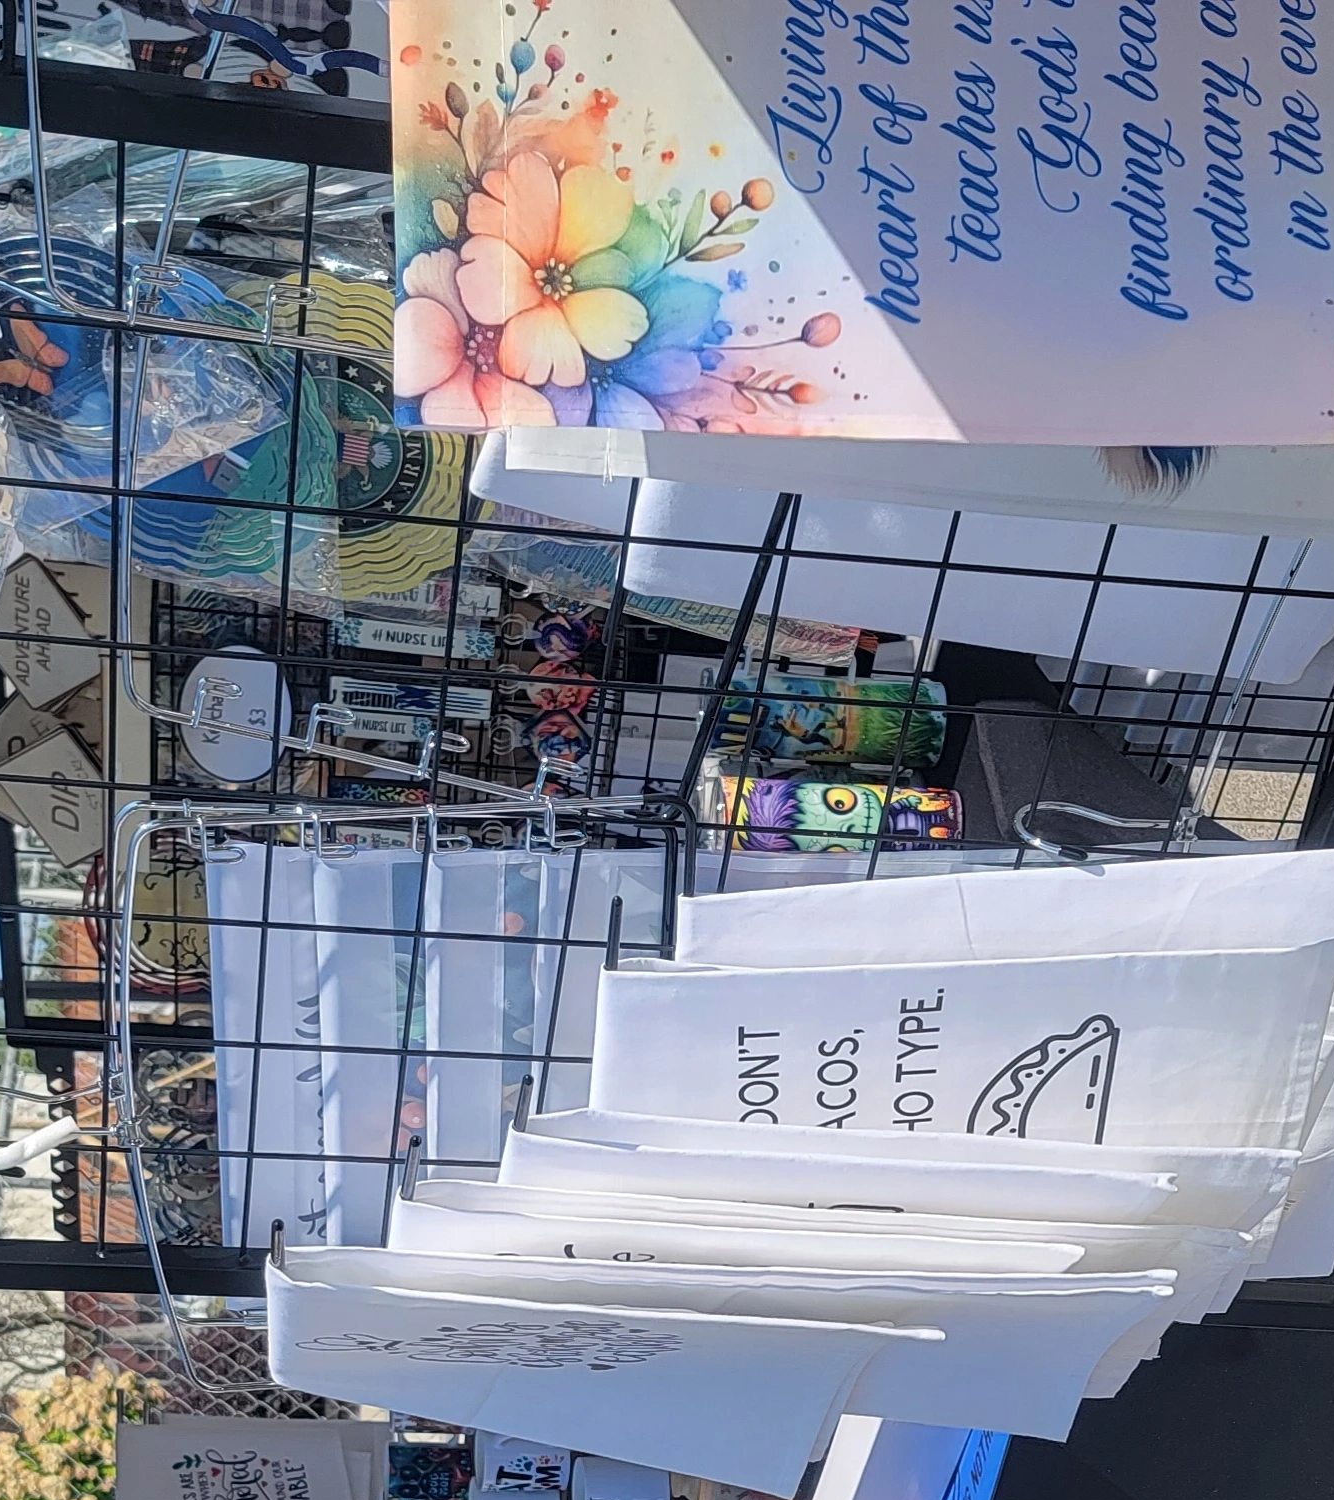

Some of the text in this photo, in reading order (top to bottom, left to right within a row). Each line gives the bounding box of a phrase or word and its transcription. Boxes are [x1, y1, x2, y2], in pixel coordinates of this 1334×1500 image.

[858, 83, 928, 146] of
[1010, 26, 1102, 213] God's
[1267, 88, 1325, 176] the
[939, 60, 1002, 263] teaches
[1192, 56, 1263, 302] ordinary
[857, 145, 922, 325] heart
[1110, 117, 1189, 321] finding
[1286, 190, 1332, 252] in
[15, 573, 30, 686] ADVENTURE
[35, 607, 51, 672] AHAD
[248, 708, 267, 727] $3
[51, 771, 80, 832] DIP
[70, 759, 103, 810] STCK!
[895, 987, 945, 1083] TYPE.
[179, 1471, 194, 1489] ARE
[197, 1471, 212, 1500] WHEN
[271, 1461, 284, 1479] OUR
[428, 1472, 438, 1494] DOG
[439, 1472, 450, 1496] MOM
